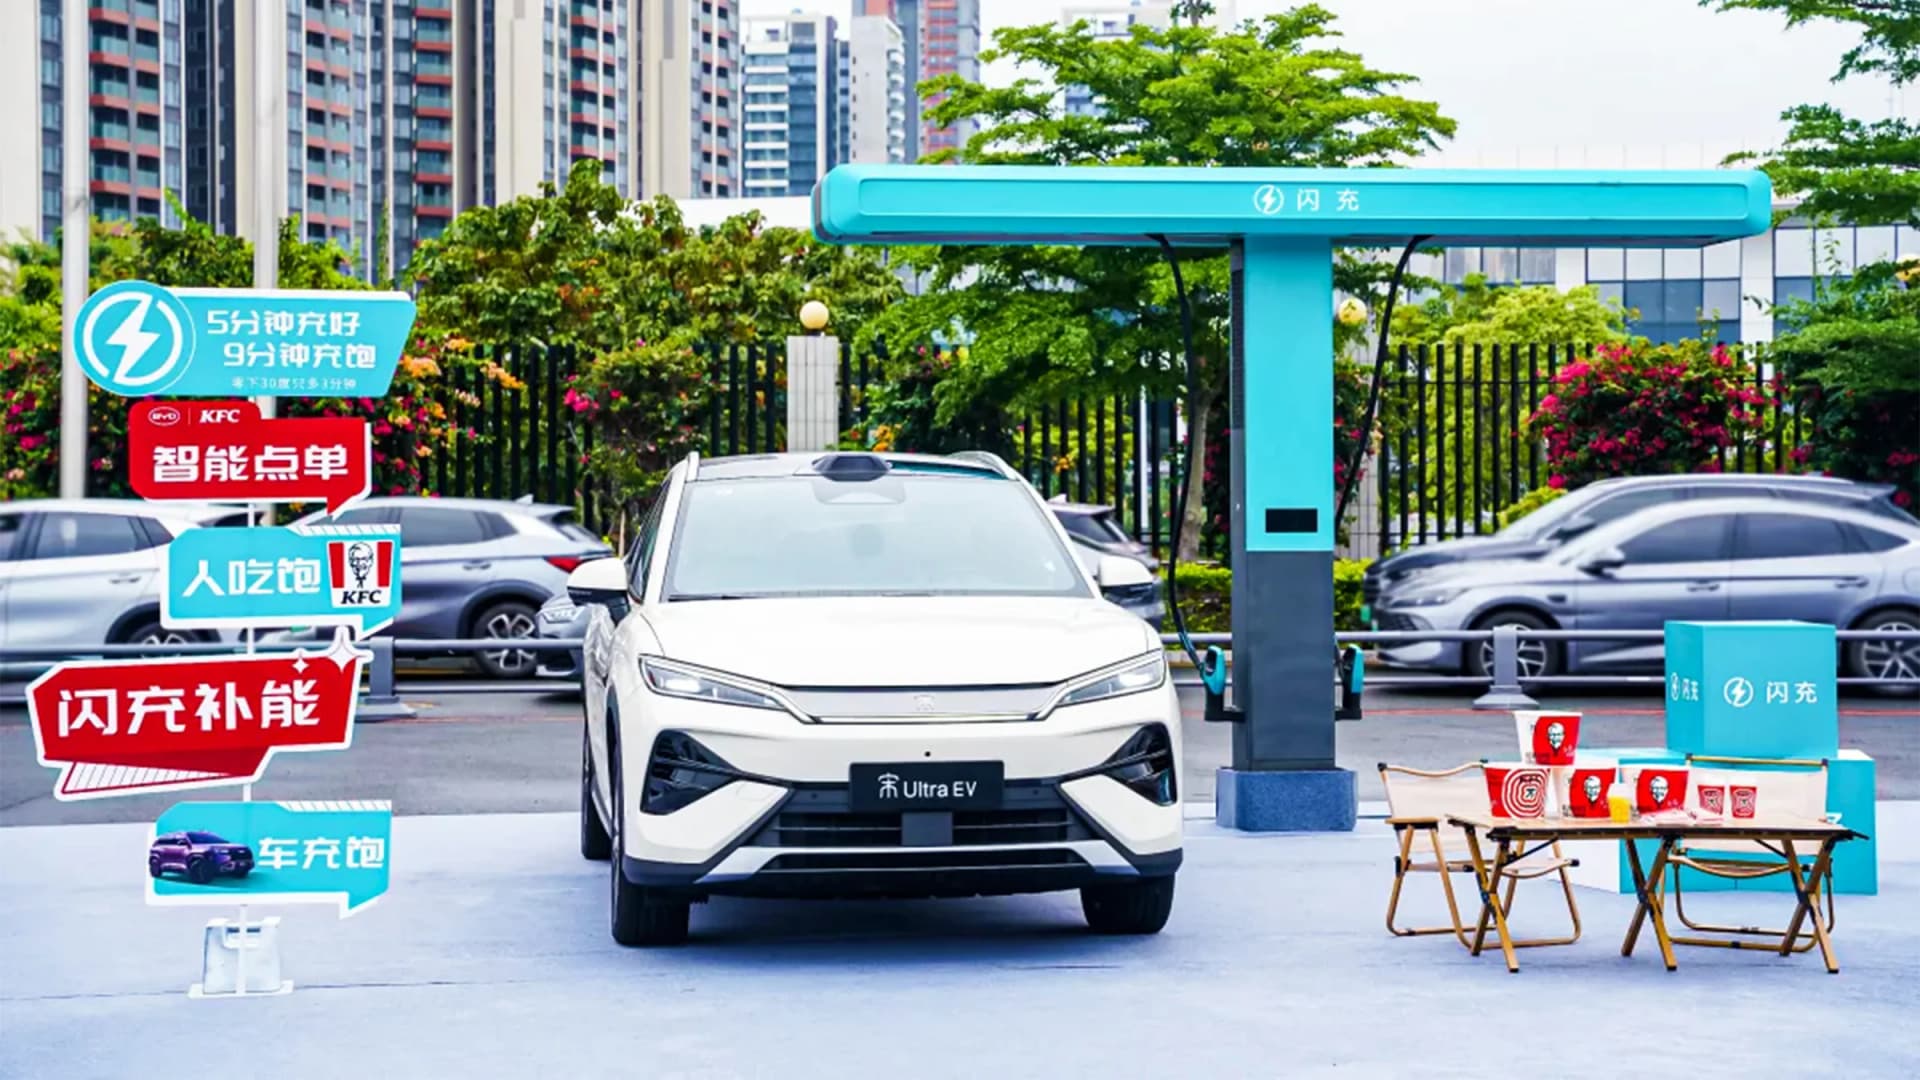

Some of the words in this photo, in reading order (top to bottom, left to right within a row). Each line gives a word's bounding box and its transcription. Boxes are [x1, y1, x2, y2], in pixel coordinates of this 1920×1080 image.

[1297, 189, 1359, 211] 闪充
[207, 310, 360, 336] 5分钟充好
[223, 342, 376, 368] 9分钟充饱
[199, 409, 240, 423] KFC
[153, 445, 348, 482] 智能点单
[183, 558, 321, 596] 人吃饱
[340, 590, 382, 604] KFC
[1766, 681, 1818, 704] 闪充
[57, 679, 320, 737] 闪充补能
[903, 781, 948, 798] Ultra
[953, 781, 976, 797] EV
[259, 837, 384, 869] 车充饱
